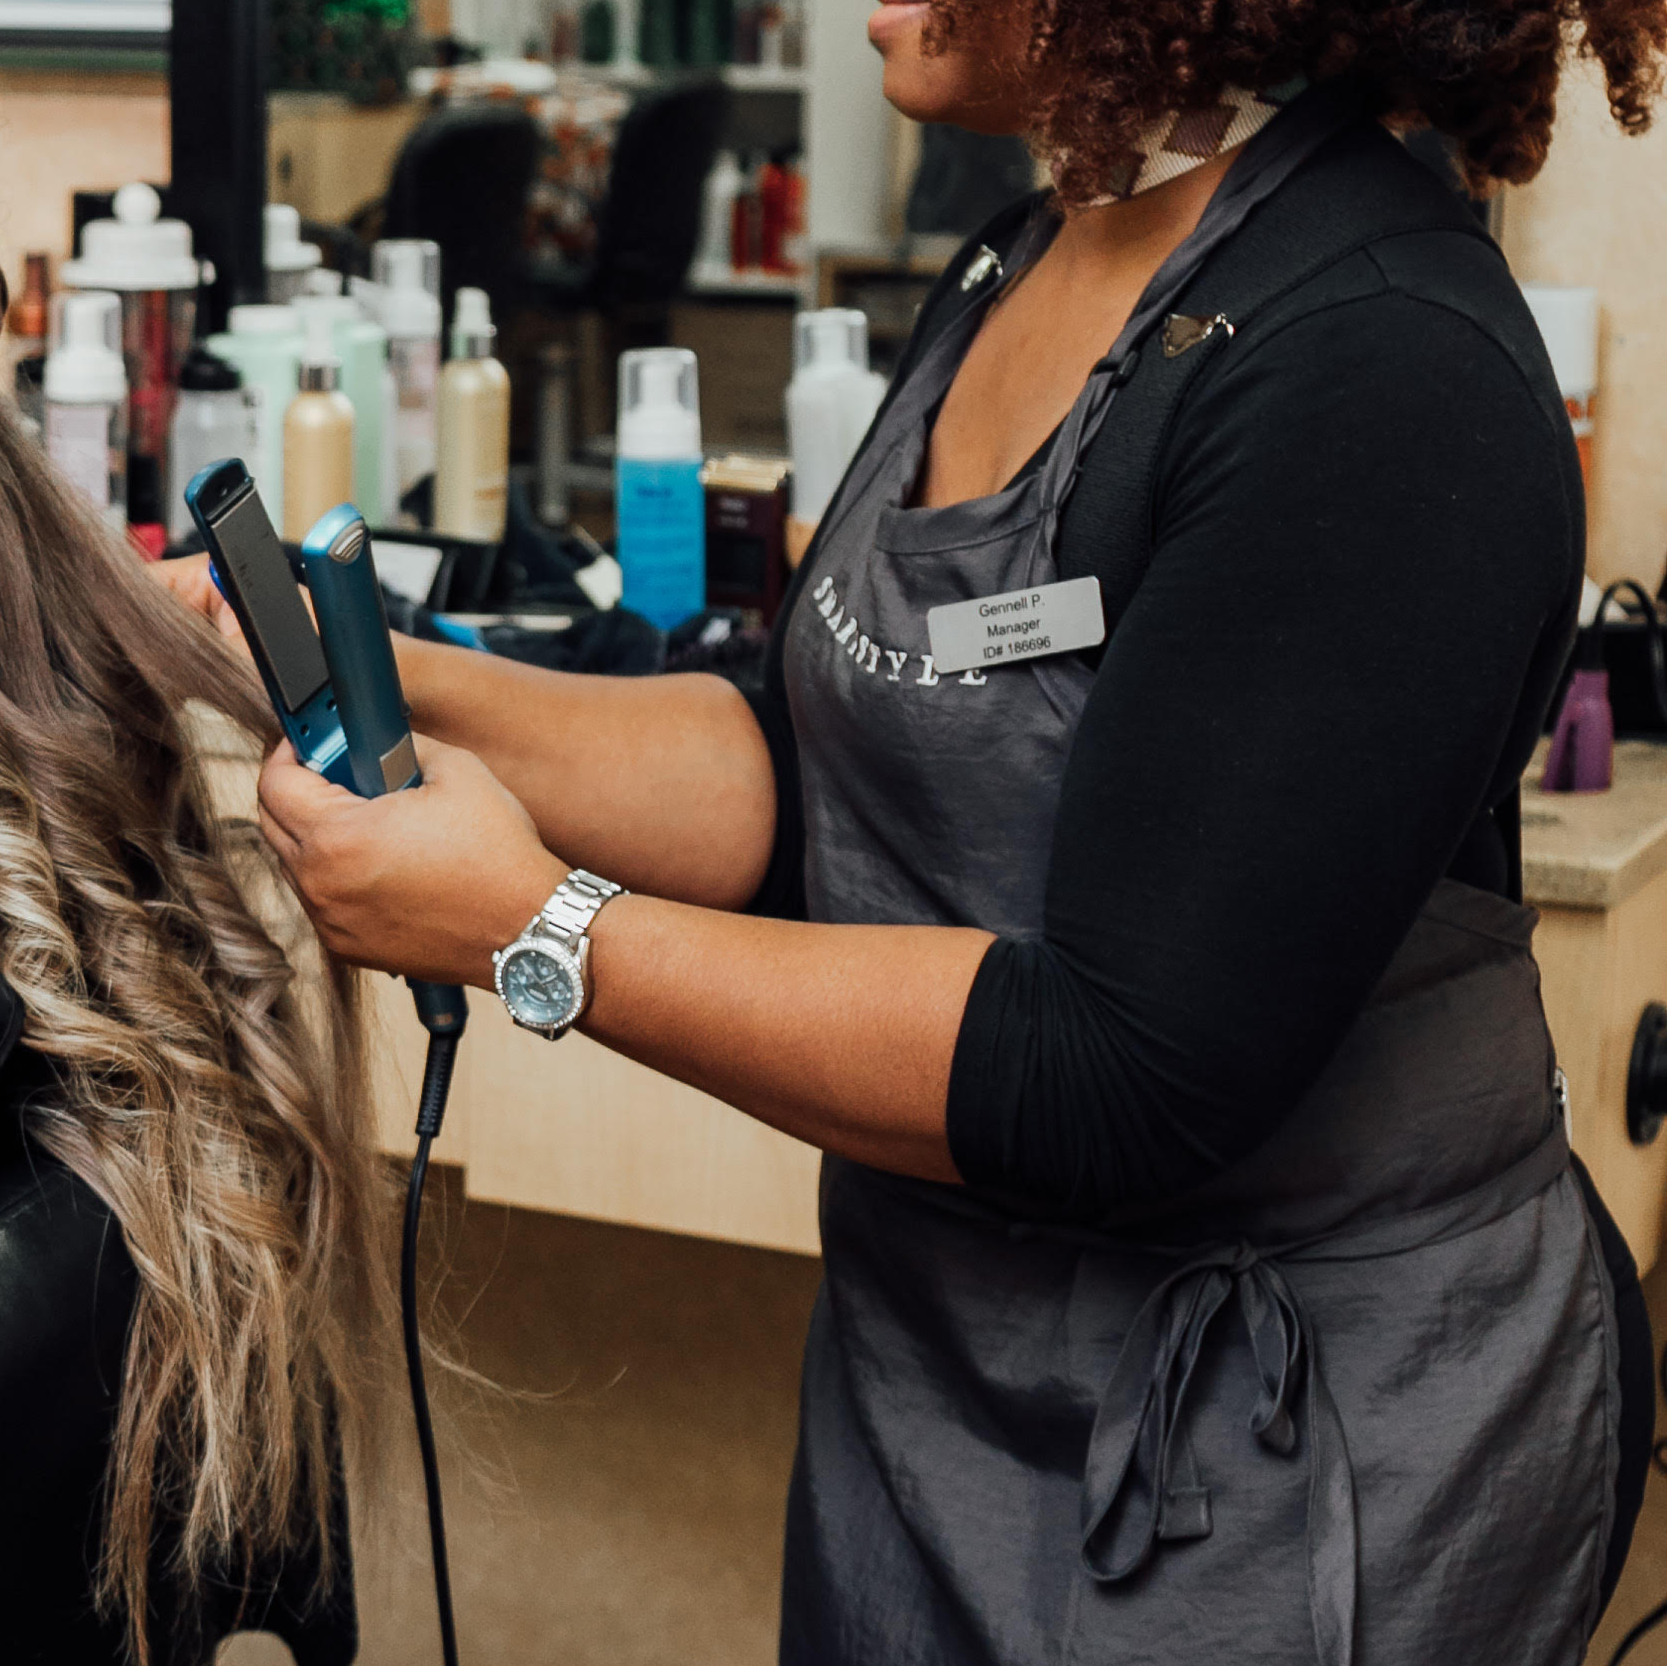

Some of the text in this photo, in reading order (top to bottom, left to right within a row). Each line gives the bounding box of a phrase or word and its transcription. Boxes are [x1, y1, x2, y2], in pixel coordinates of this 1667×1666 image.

[979, 593, 1046, 618] Gennell P.
[987, 619, 1041, 638] Manager
[983, 635, 1051, 659] ID# 186696
